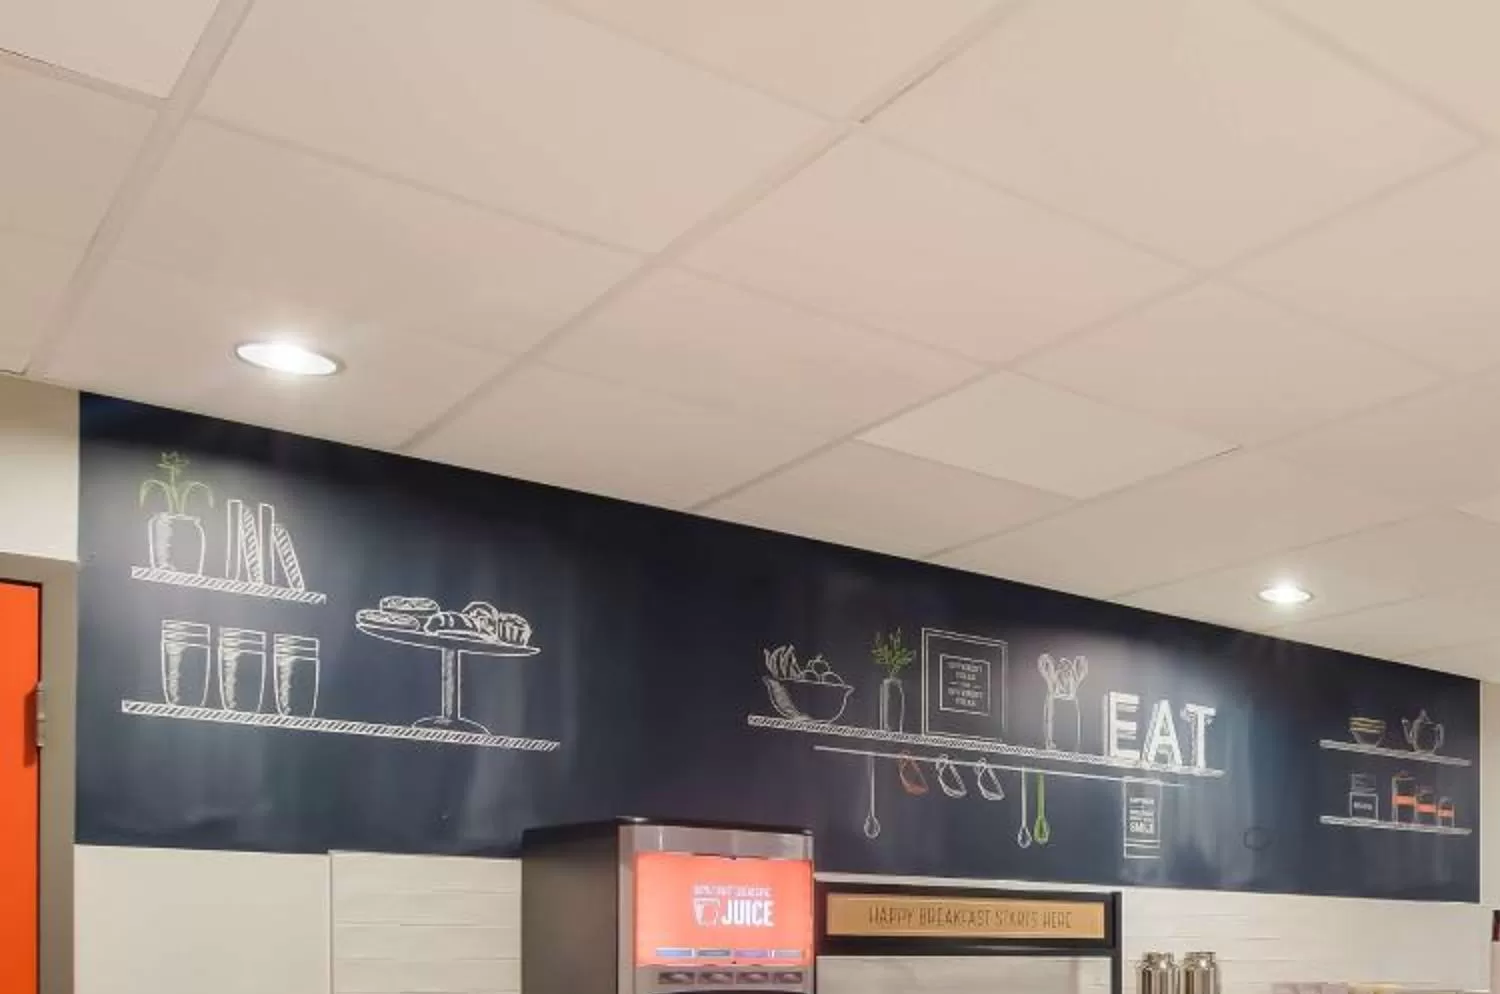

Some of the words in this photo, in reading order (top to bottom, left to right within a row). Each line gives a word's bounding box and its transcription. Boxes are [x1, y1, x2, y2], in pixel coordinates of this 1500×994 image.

[1103, 691, 1217, 769] EAT
[721, 899, 775, 925] JUICE
[868, 906, 914, 925] HAPPY
[919, 907, 993, 927] BREAKFAST
